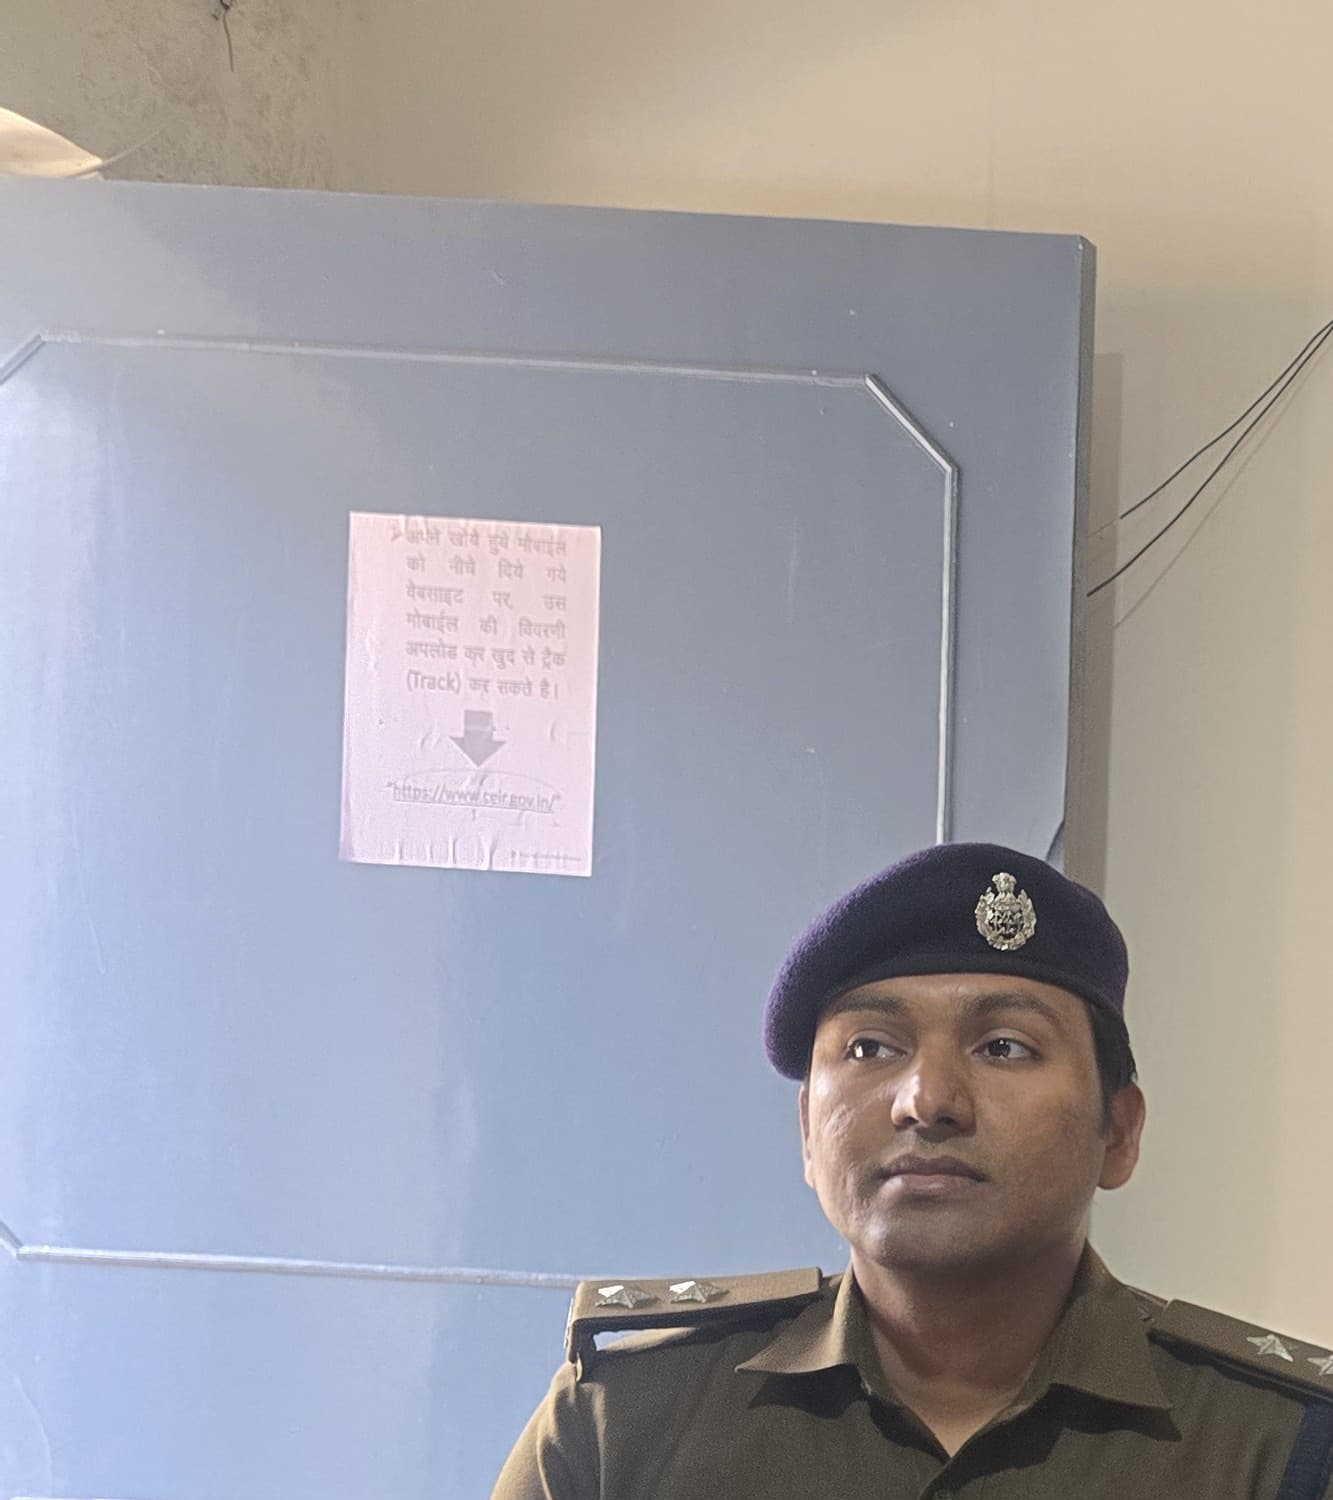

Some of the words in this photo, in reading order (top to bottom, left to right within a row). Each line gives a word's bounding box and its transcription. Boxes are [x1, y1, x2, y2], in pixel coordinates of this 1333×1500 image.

[448, 555, 476, 577] नीचे
[497, 558, 524, 582] दिये
[480, 614, 498, 637] की
[406, 670, 461, 693] (Track)
